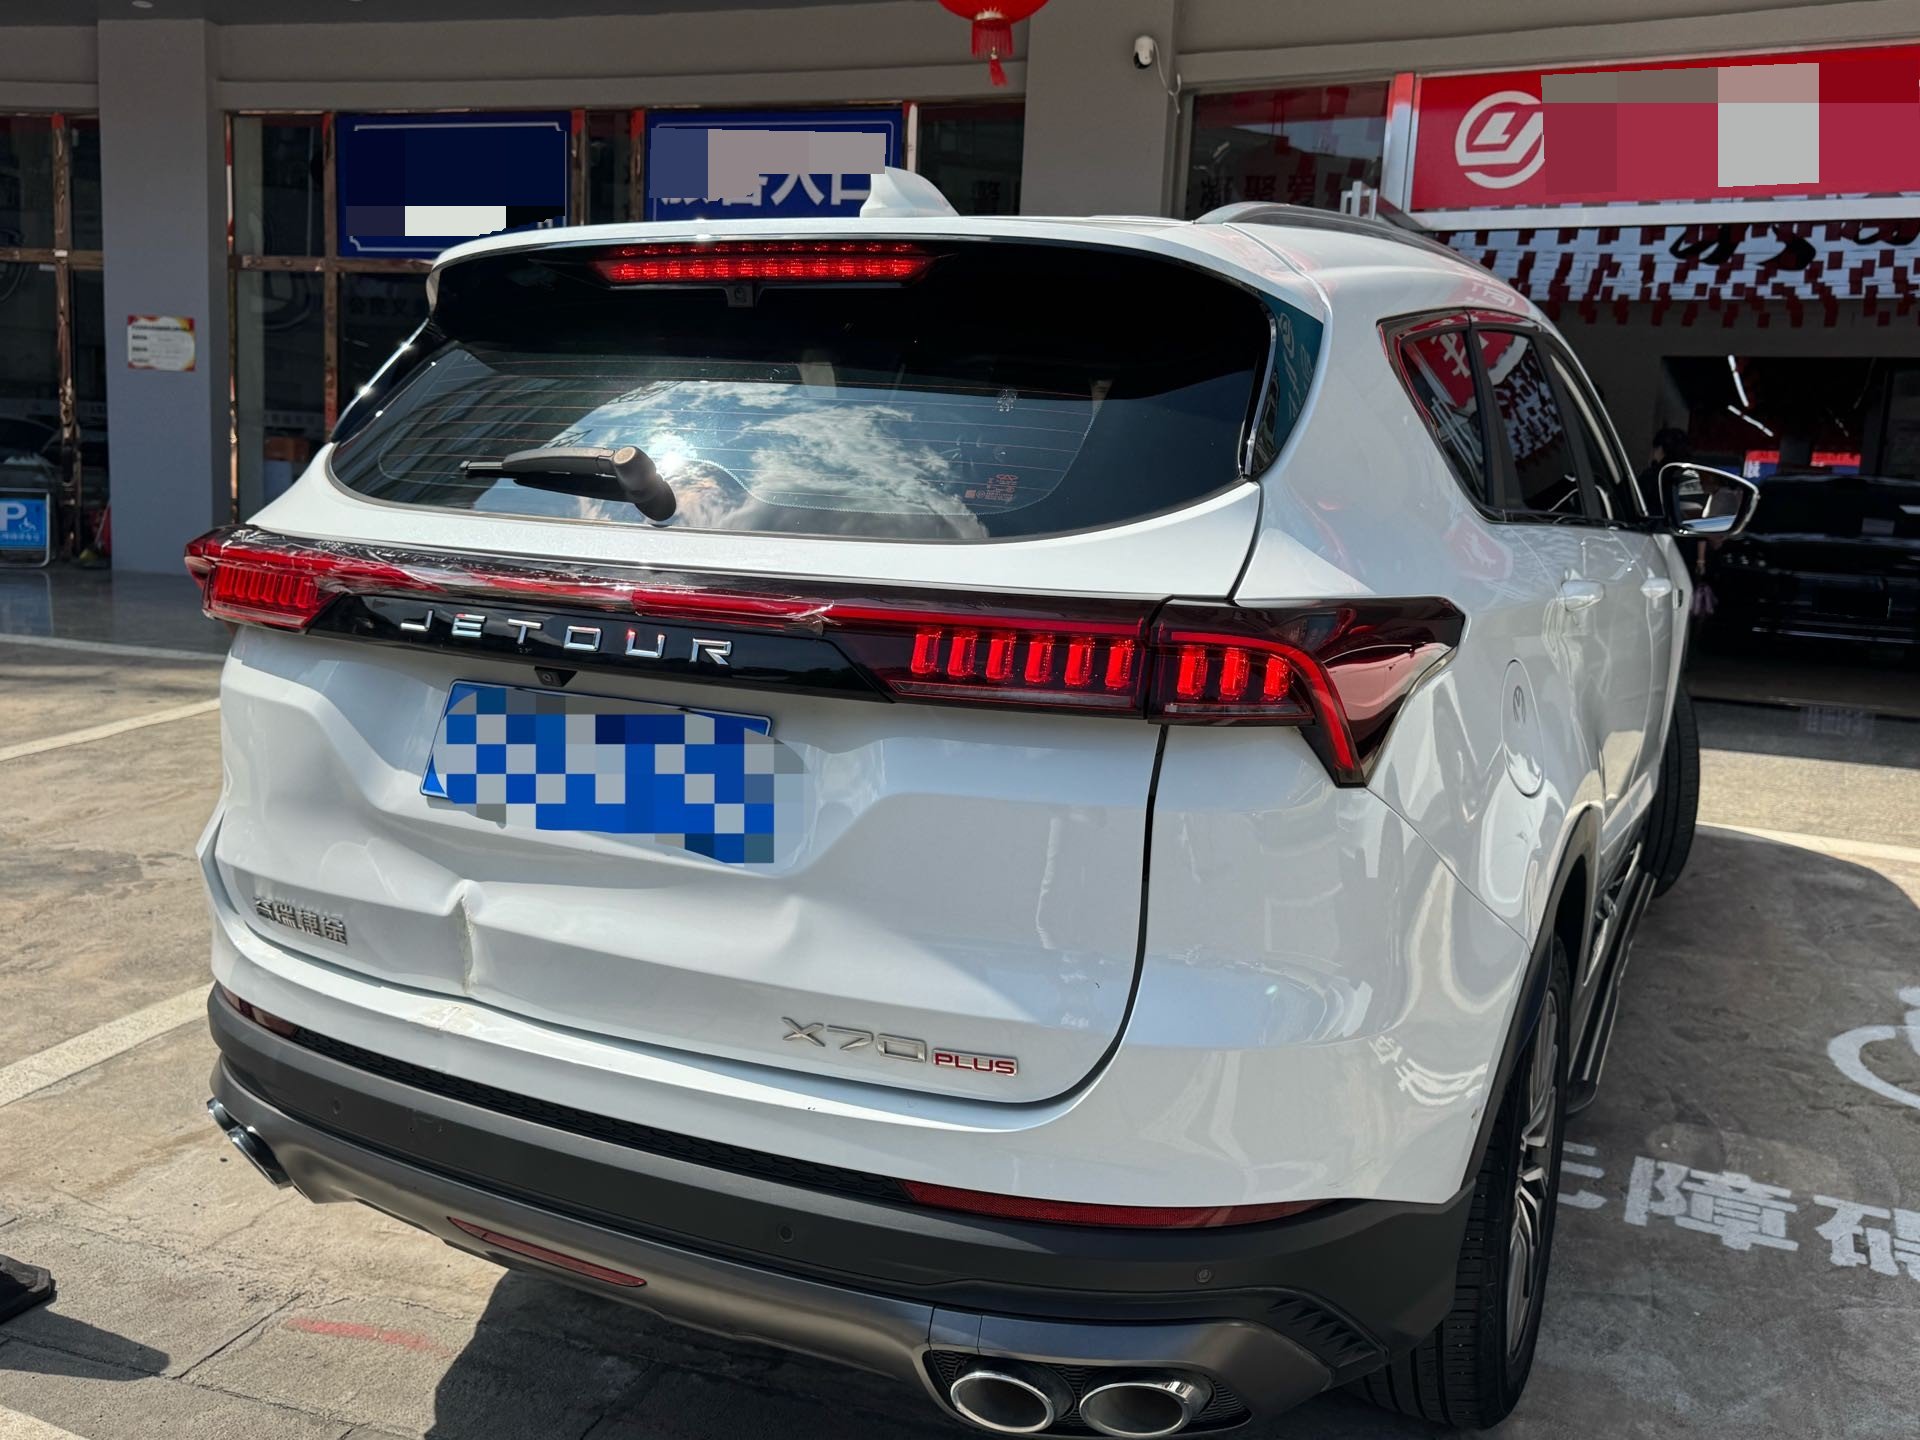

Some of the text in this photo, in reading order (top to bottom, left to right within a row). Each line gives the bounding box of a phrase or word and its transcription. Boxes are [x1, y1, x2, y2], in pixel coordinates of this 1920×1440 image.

[400, 609, 733, 665] JETOUR
[253, 895, 348, 945] 奇瑞捷途
[781, 1016, 1016, 1075] X70 PLUS
